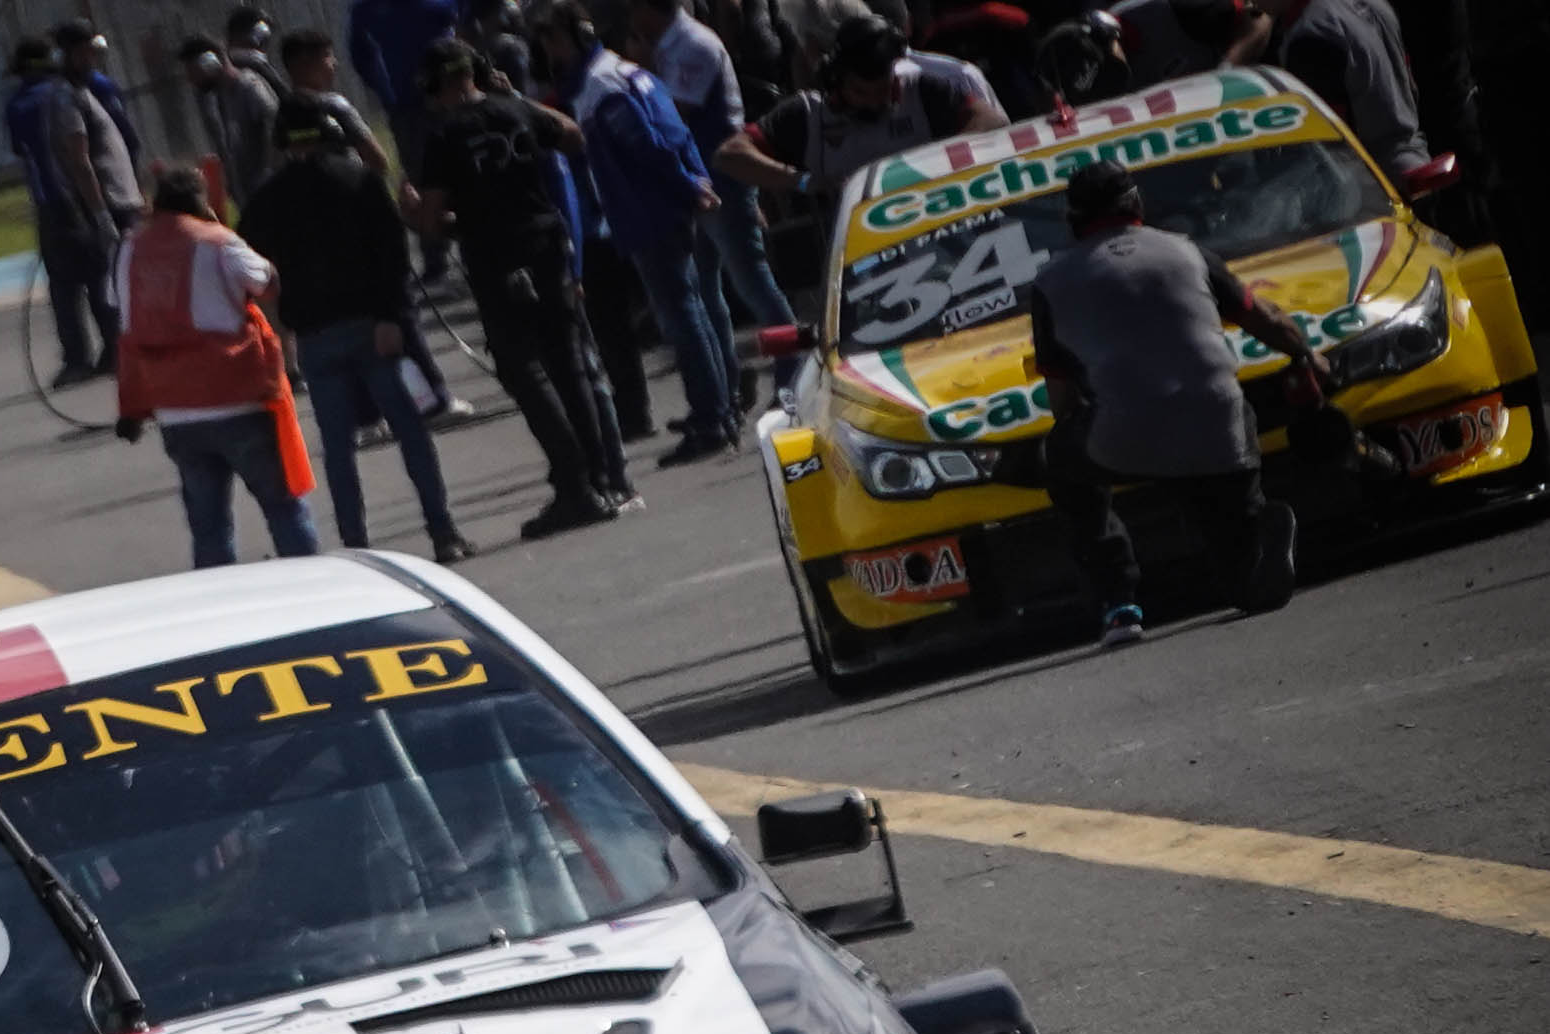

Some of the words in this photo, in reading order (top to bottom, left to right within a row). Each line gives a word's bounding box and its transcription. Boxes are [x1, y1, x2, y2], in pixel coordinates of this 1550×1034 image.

[866, 104, 1303, 228] Cachamate
[846, 220, 1050, 344] 34
[784, 456, 822, 481] 34
